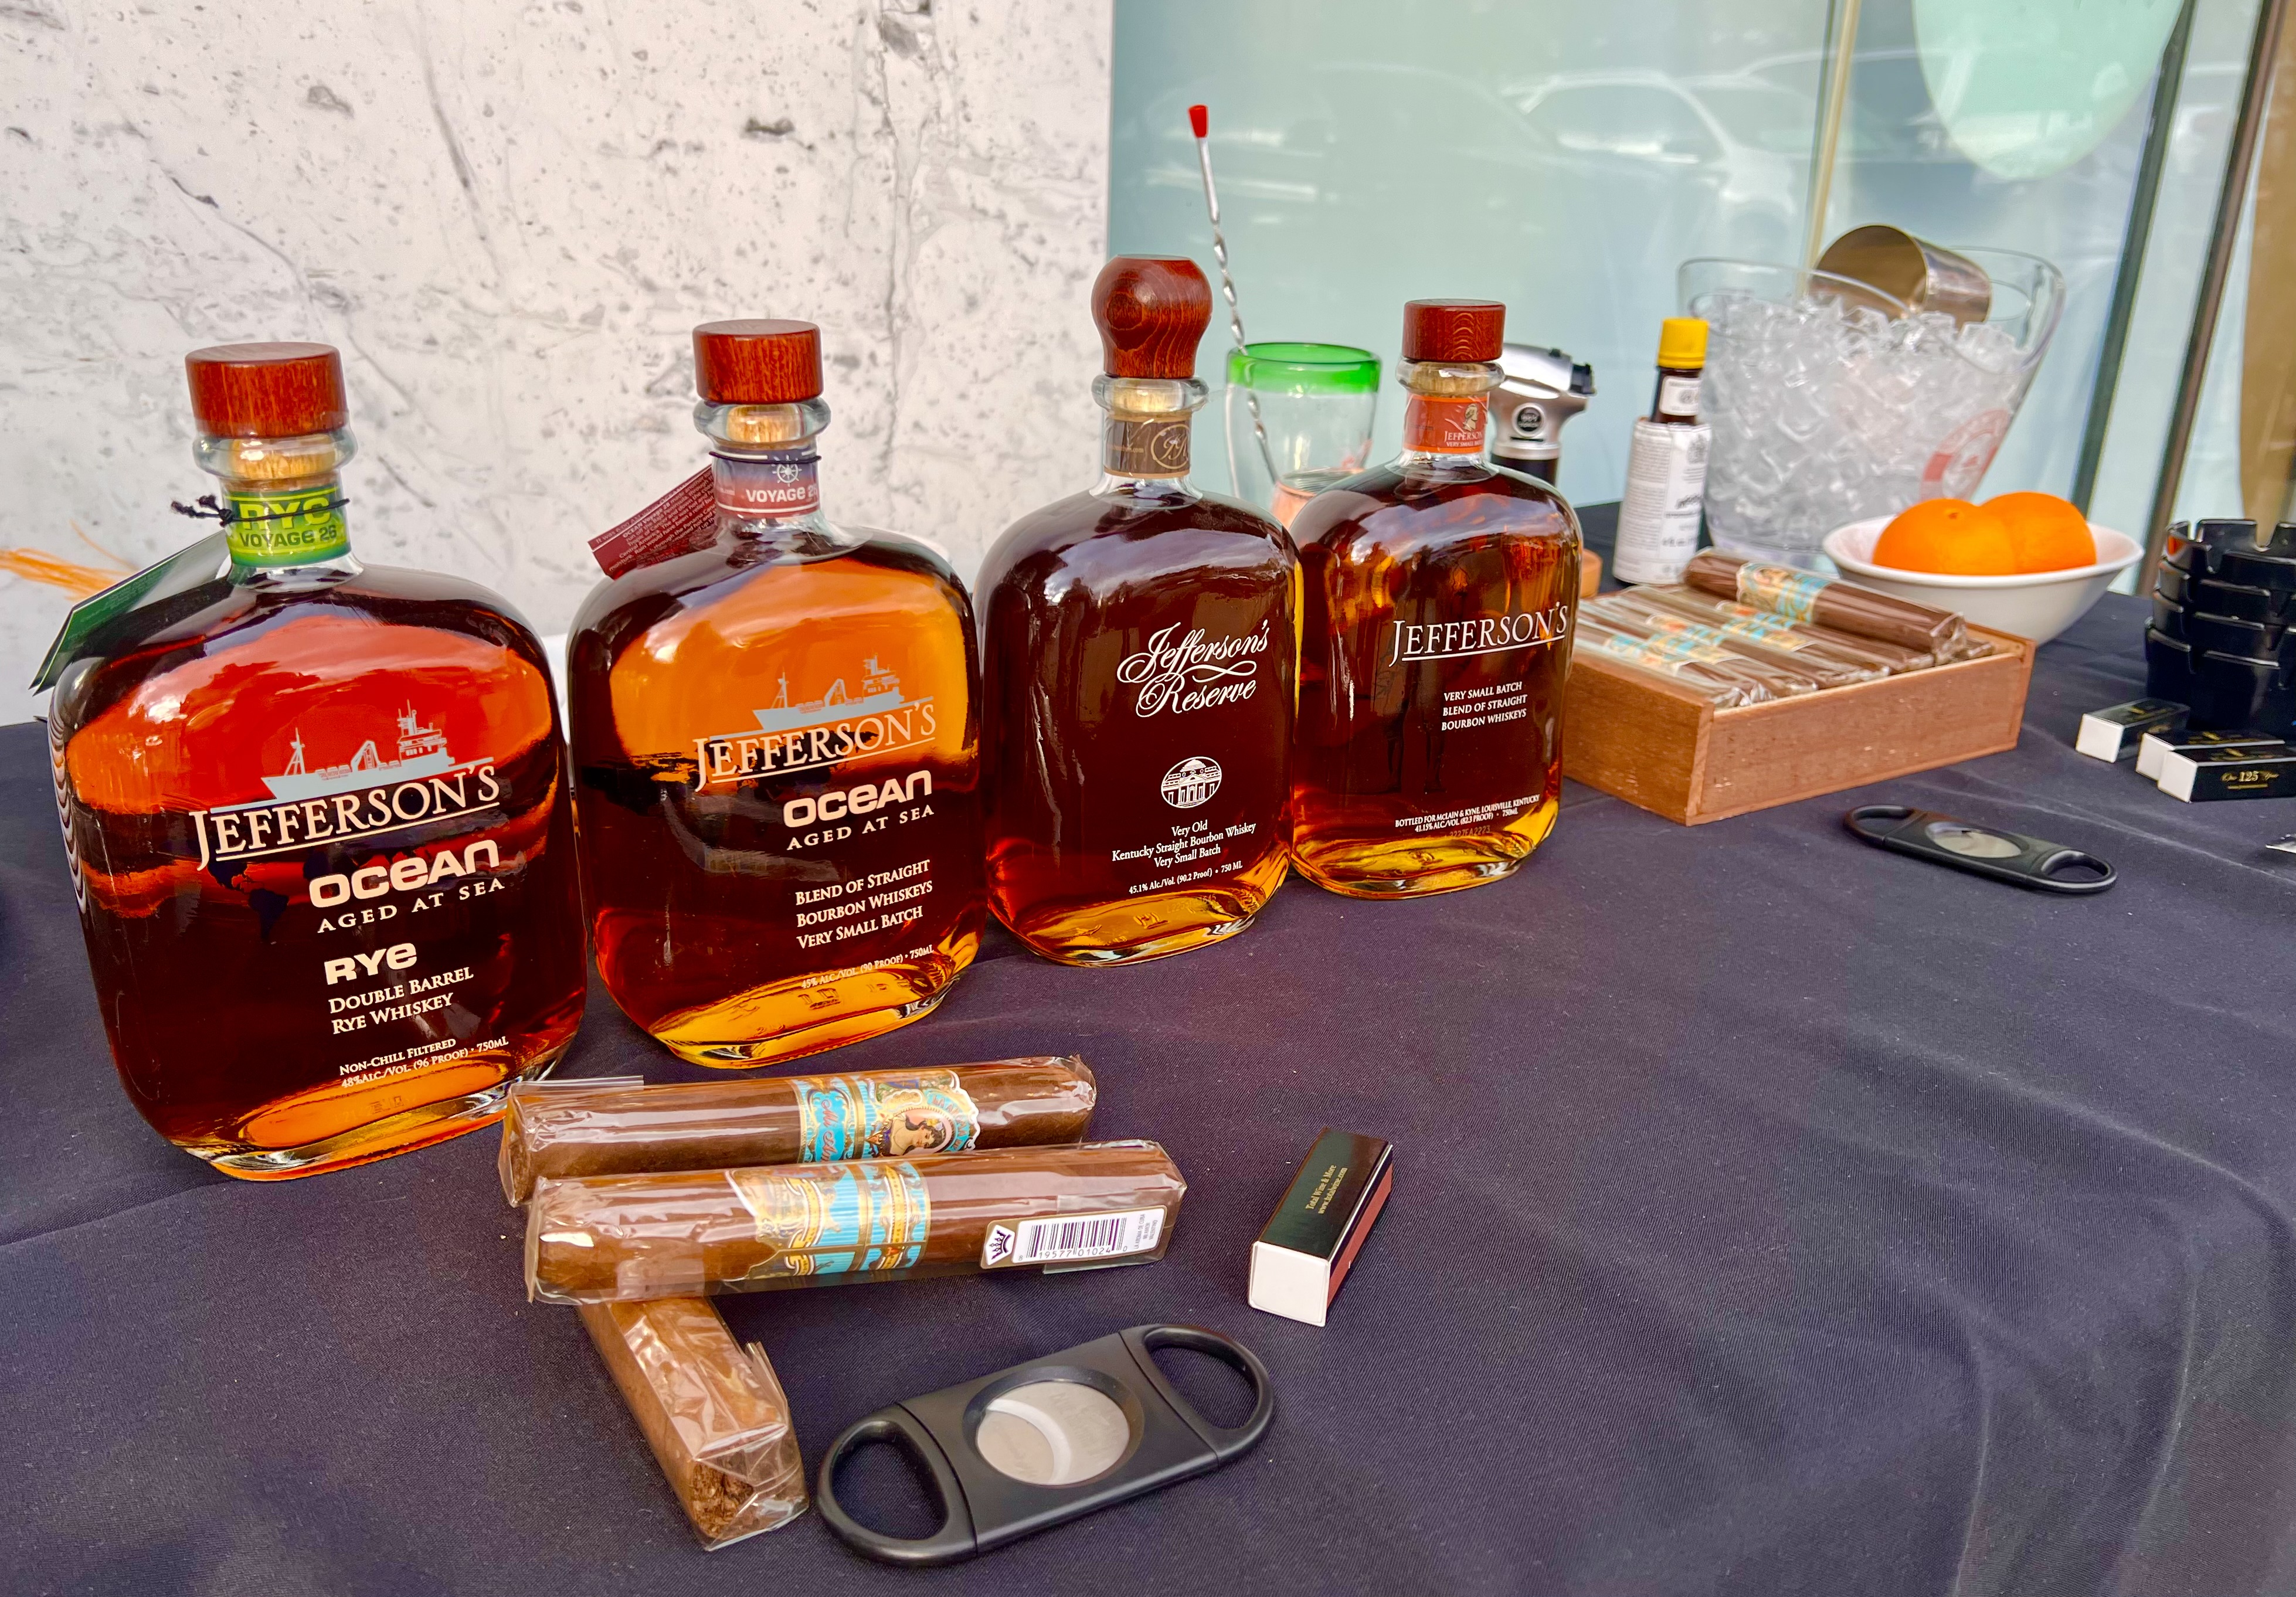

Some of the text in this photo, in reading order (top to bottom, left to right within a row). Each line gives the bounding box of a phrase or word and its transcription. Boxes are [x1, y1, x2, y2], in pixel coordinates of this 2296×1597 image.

[1117, 619, 1270, 684] Jefferson's
[1389, 602, 1569, 668] JEFFERSON'S
[1136, 672, 1257, 718] Reserve
[1442, 694, 1528, 716] BLEND OF STRAIGHT
[1444, 681, 1523, 702] VERY SMALL BATCH
[1441, 708, 1527, 731] BOURBON WHISKEYS
[692, 702, 937, 793] JEFFERSON'S
[2239, 770, 2259, 782] 125
[189, 764, 500, 871] JEFFERSON'S
[786, 804, 935, 851] AGED AT SEA
[1171, 820, 1208, 837] Very Old
[1395, 817, 1424, 827] BOTTLED
[1424, 814, 1436, 824] FOR
[1513, 794, 1540, 807] KENTUCKY
[1473, 811, 1494, 823] PROOF)
[1112, 823, 1256, 862] Kentucky Straight Bourbon Whiskey
[1154, 843, 1221, 868] Very Small Batch
[795, 859, 930, 906] BLEND OF STRAIGHT
[1129, 884, 1148, 895] 45.1%
[1177, 872, 1192, 885] (90.2
[1193, 868, 1213, 881] Proof)
[1221, 863, 1232, 873] 750
[1232, 860, 1243, 870] ML
[317, 878, 505, 933] AGED AT SEA
[796, 881, 933, 927] BOURBON WHISKEYS
[796, 905, 923, 949] VERY SMALL BATCH
[801, 976, 818, 989] 45%
[860, 962, 873, 974] (90
[874, 953, 904, 970] PROOF)
[328, 967, 474, 1014] DOUBLE BARREL
[331, 993, 454, 1035] RYE WHISKEY
[339, 1038, 456, 1076] NON-CHILL FILTERED
[413, 1058, 430, 1072] (96
[431, 1048, 469, 1066] PROOF)
[1039, 1250, 1072, 1258] 19577
[1078, 1248, 1111, 1257] 01024
